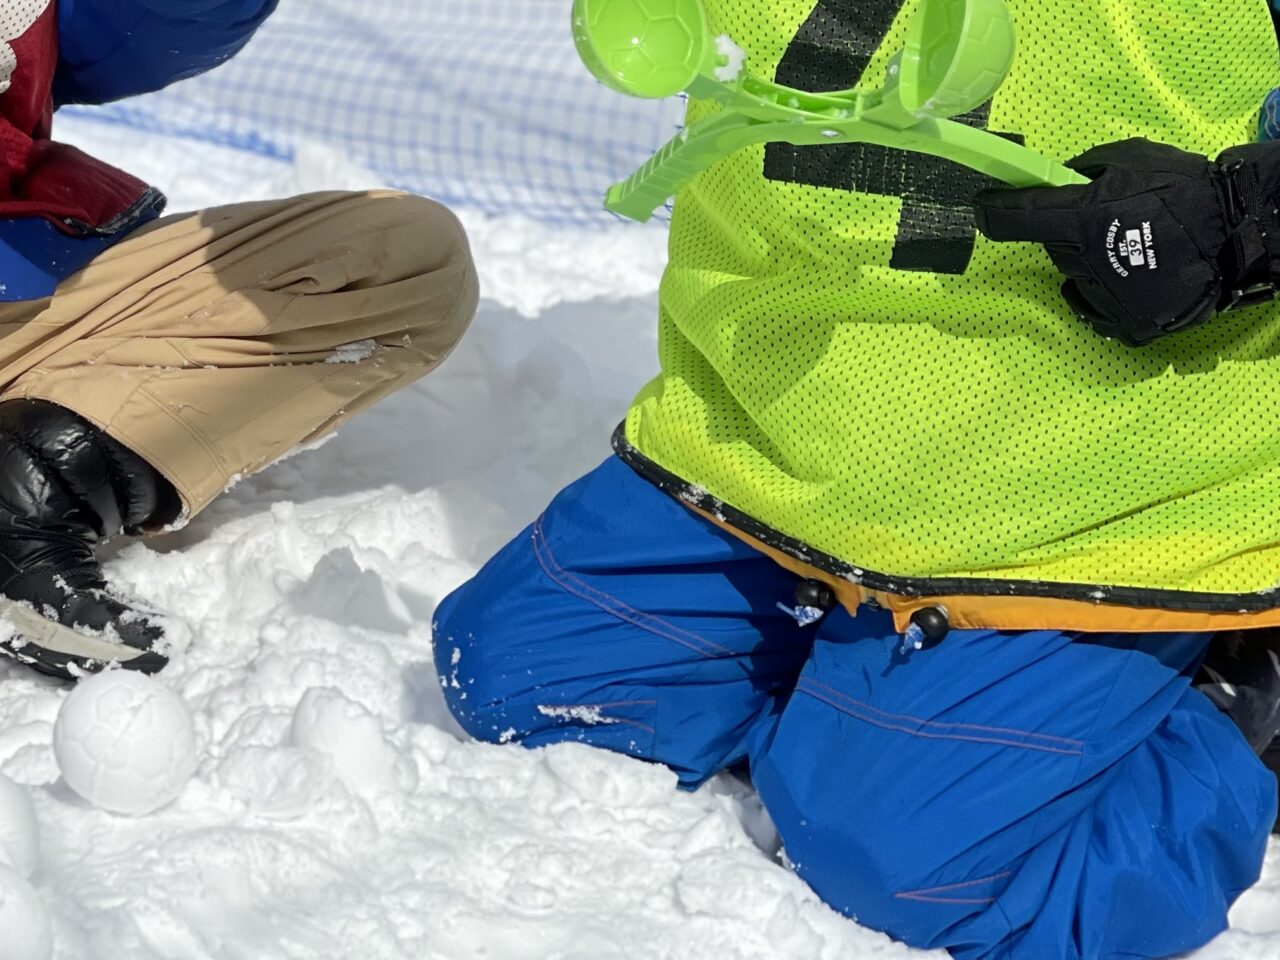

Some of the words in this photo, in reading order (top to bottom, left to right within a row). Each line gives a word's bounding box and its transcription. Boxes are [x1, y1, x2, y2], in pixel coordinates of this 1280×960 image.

[1106, 219, 1121, 249] COSBY
[1142, 221, 1153, 247] YORK
[1129, 239, 1142, 256] 39
[1146, 249, 1157, 270] NEW
[1107, 250, 1129, 277] GERRY
